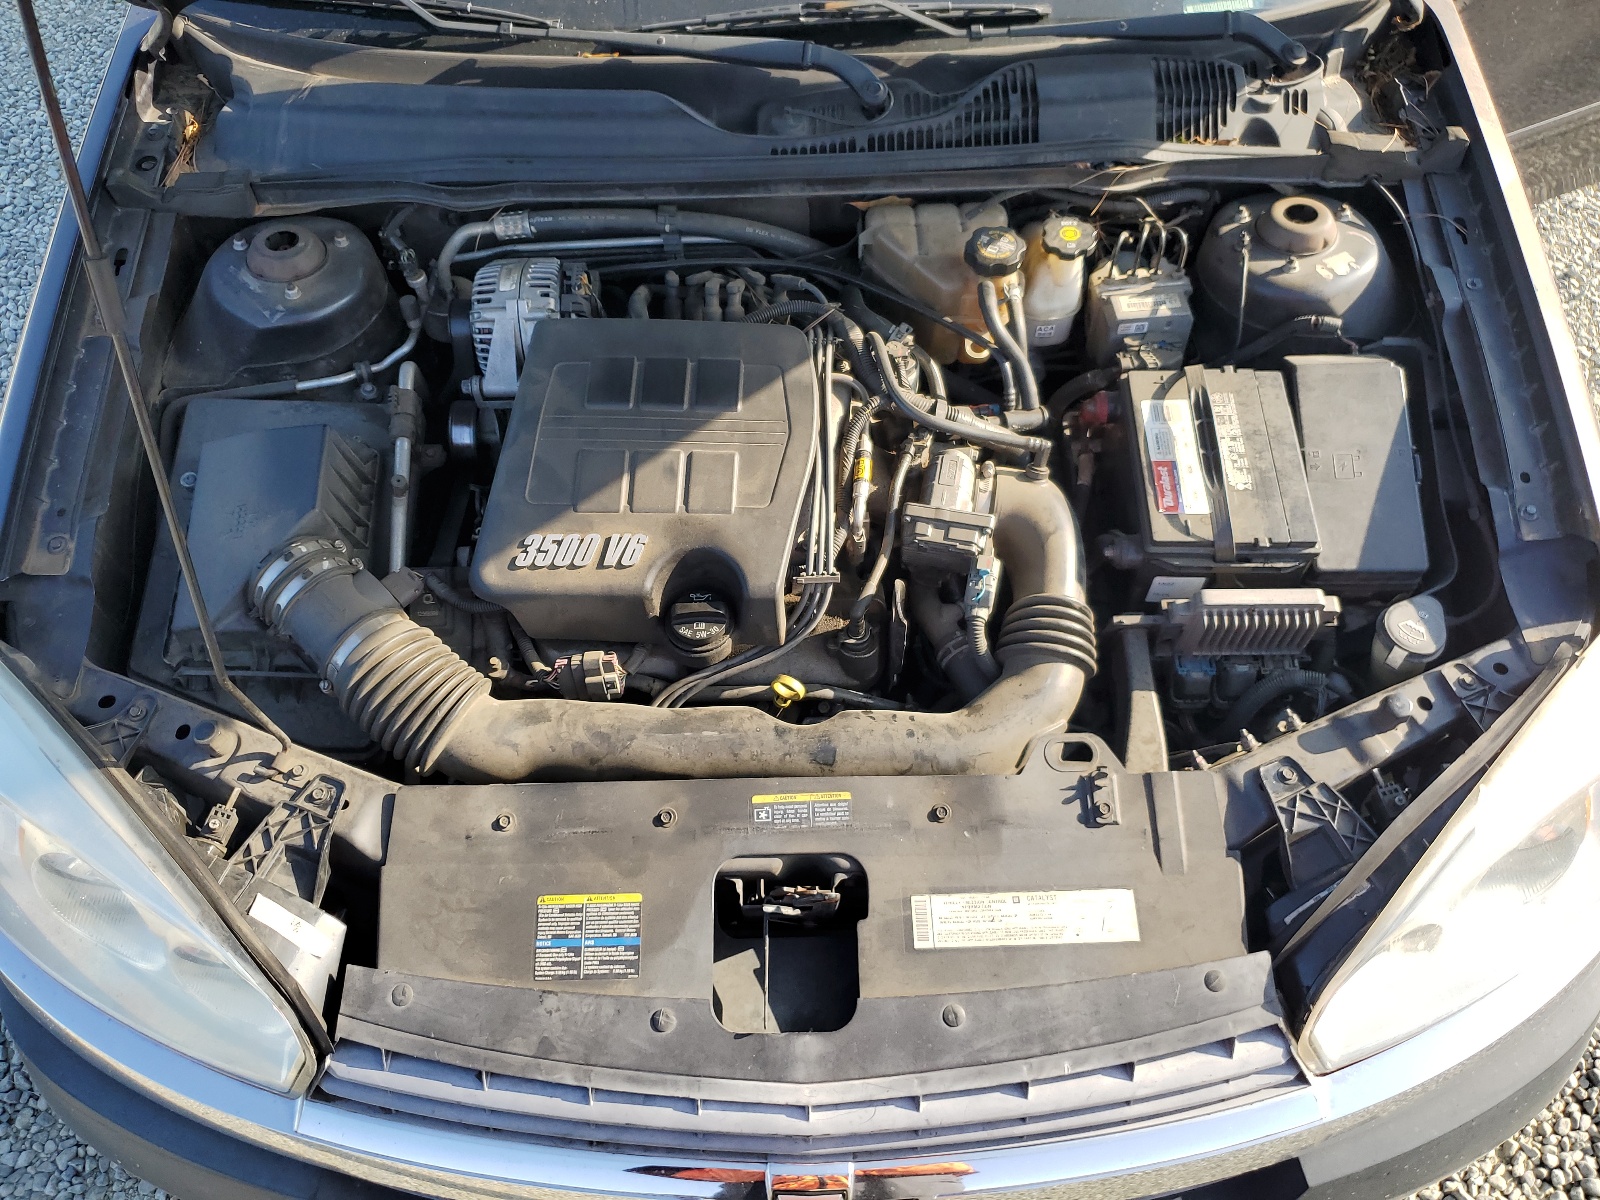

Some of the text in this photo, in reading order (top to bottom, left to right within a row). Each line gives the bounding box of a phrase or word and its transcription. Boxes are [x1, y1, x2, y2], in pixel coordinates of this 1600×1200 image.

[1157, 466, 1175, 508] Duralast
[514, 533, 649, 567] 3500 V6
[679, 625, 719, 639] SAE 5W-30
